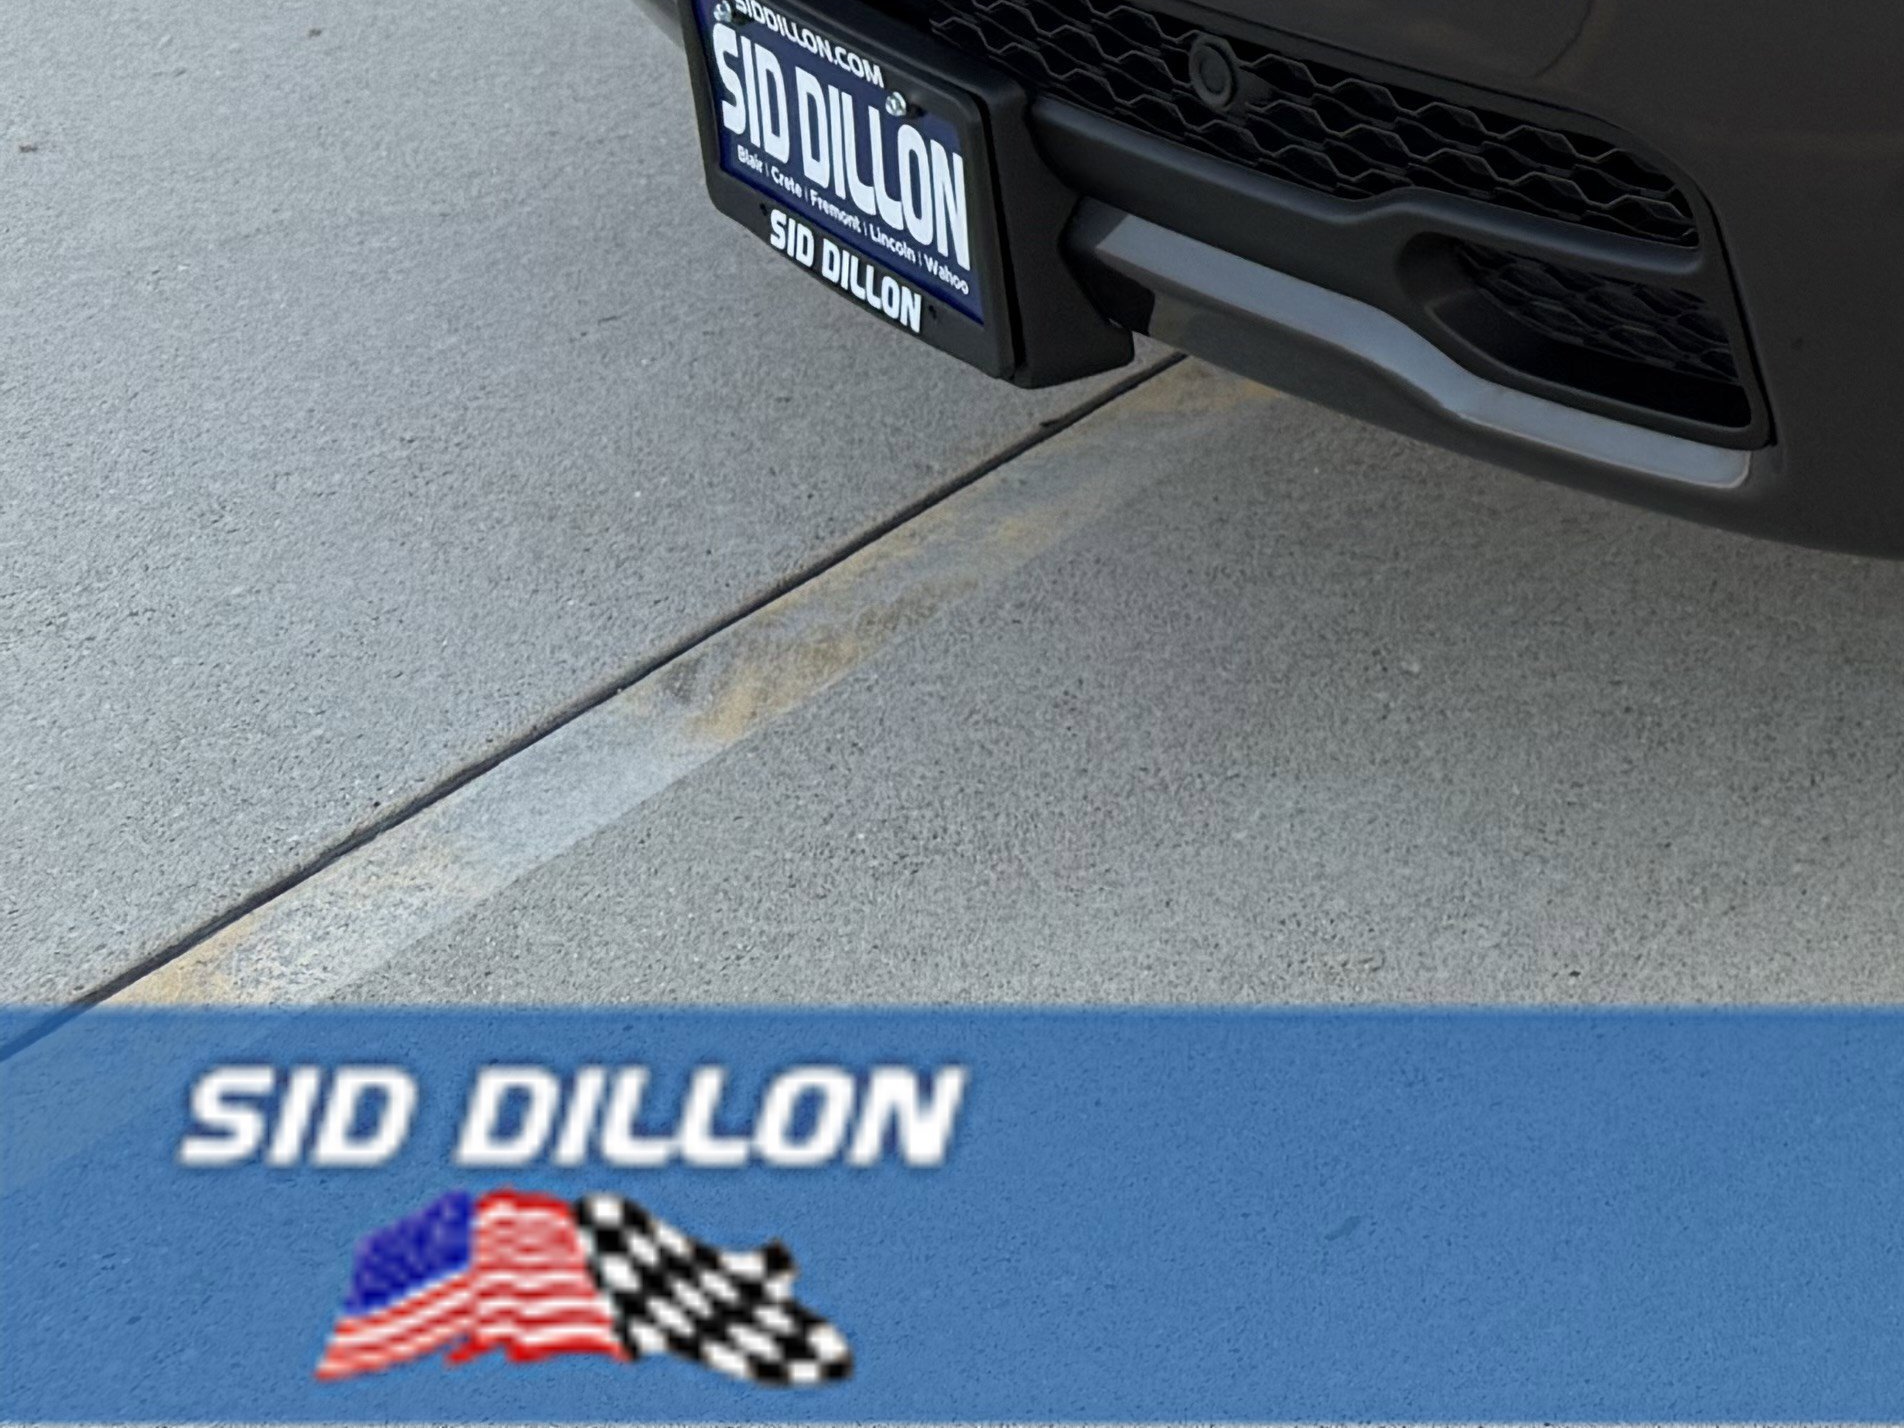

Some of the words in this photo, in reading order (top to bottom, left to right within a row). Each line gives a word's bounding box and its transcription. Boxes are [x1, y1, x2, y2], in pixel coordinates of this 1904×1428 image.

[711, 20, 792, 165] SID
[795, 64, 972, 272] DILLON
[736, 144, 764, 174] Blair
[770, 165, 803, 198] Crete
[809, 189, 862, 233] Fremont
[869, 222, 917, 264] Lincoln
[923, 252, 970, 296] Wahoo
[769, 208, 816, 268] SID
[821, 237, 924, 334] DILLON
